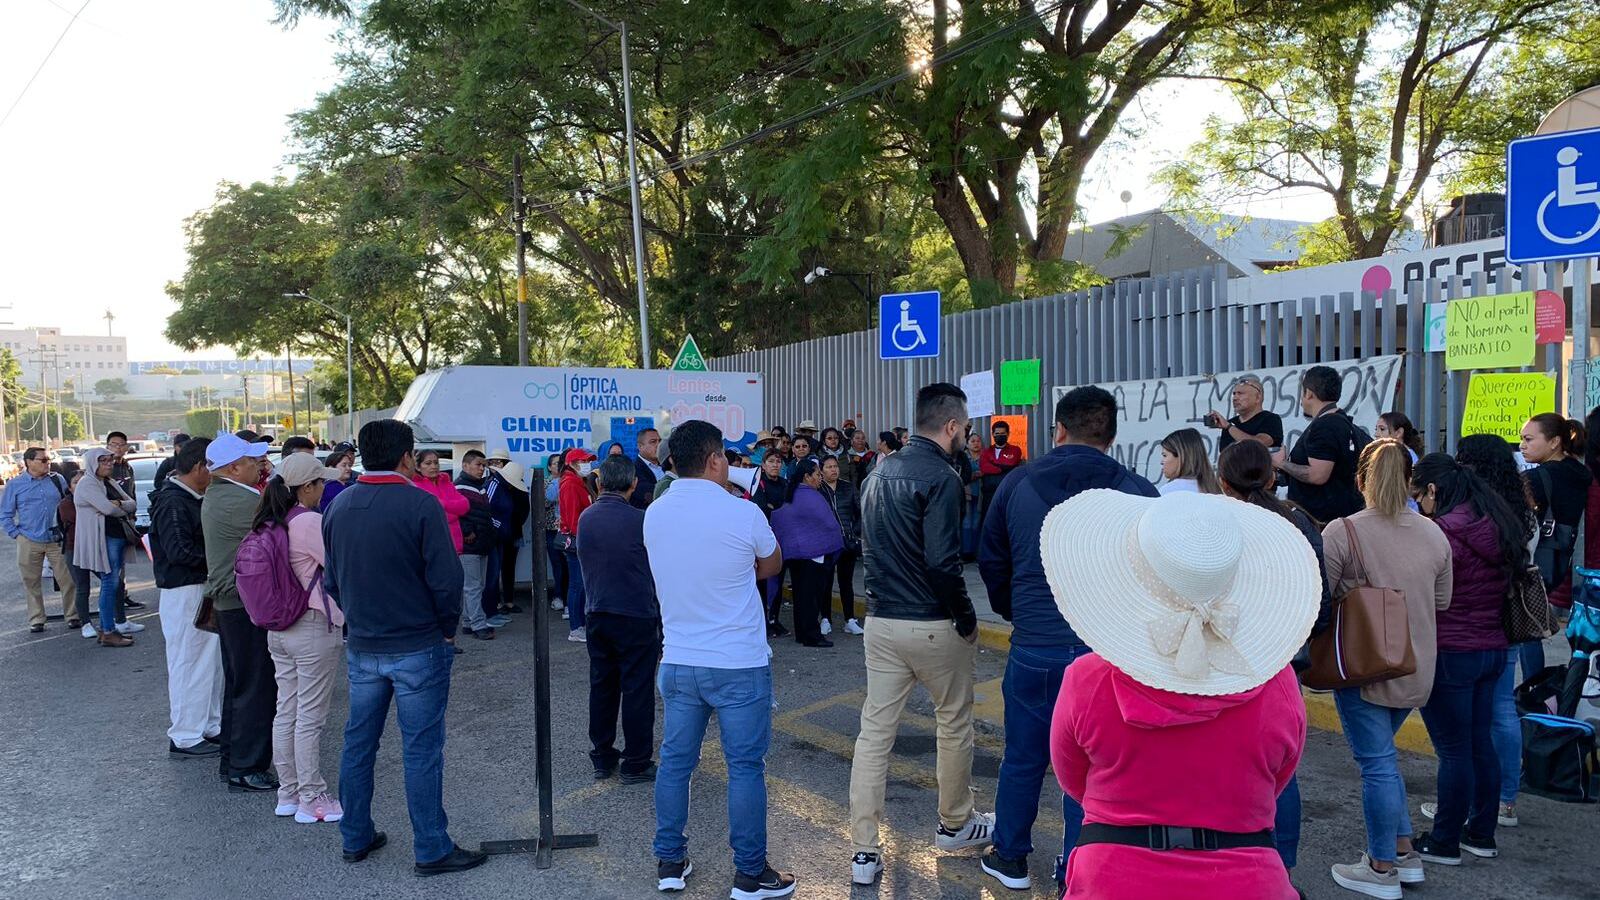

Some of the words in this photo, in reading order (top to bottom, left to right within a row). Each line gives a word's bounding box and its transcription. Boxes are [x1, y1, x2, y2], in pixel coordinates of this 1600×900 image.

[1454, 300, 1480, 323] NO
[1484, 297, 1496, 319] al
[1499, 296, 1529, 321] portal
[1448, 325, 1460, 337] de
[1519, 325, 1528, 334] a
[1449, 340, 1511, 358] BANBAJIO
[570, 373, 618, 395] ÓPTICA
[668, 373, 721, 394] Lentes
[570, 394, 642, 411] CIMATARIO
[704, 393, 727, 402] desde
[1138, 380, 1170, 422] LA
[1469, 399, 1488, 409] nos
[1494, 397, 1517, 408] vea
[1529, 395, 1537, 411] y
[501, 414, 592, 432] CLÍNICA
[1519, 406, 1532, 423] el
